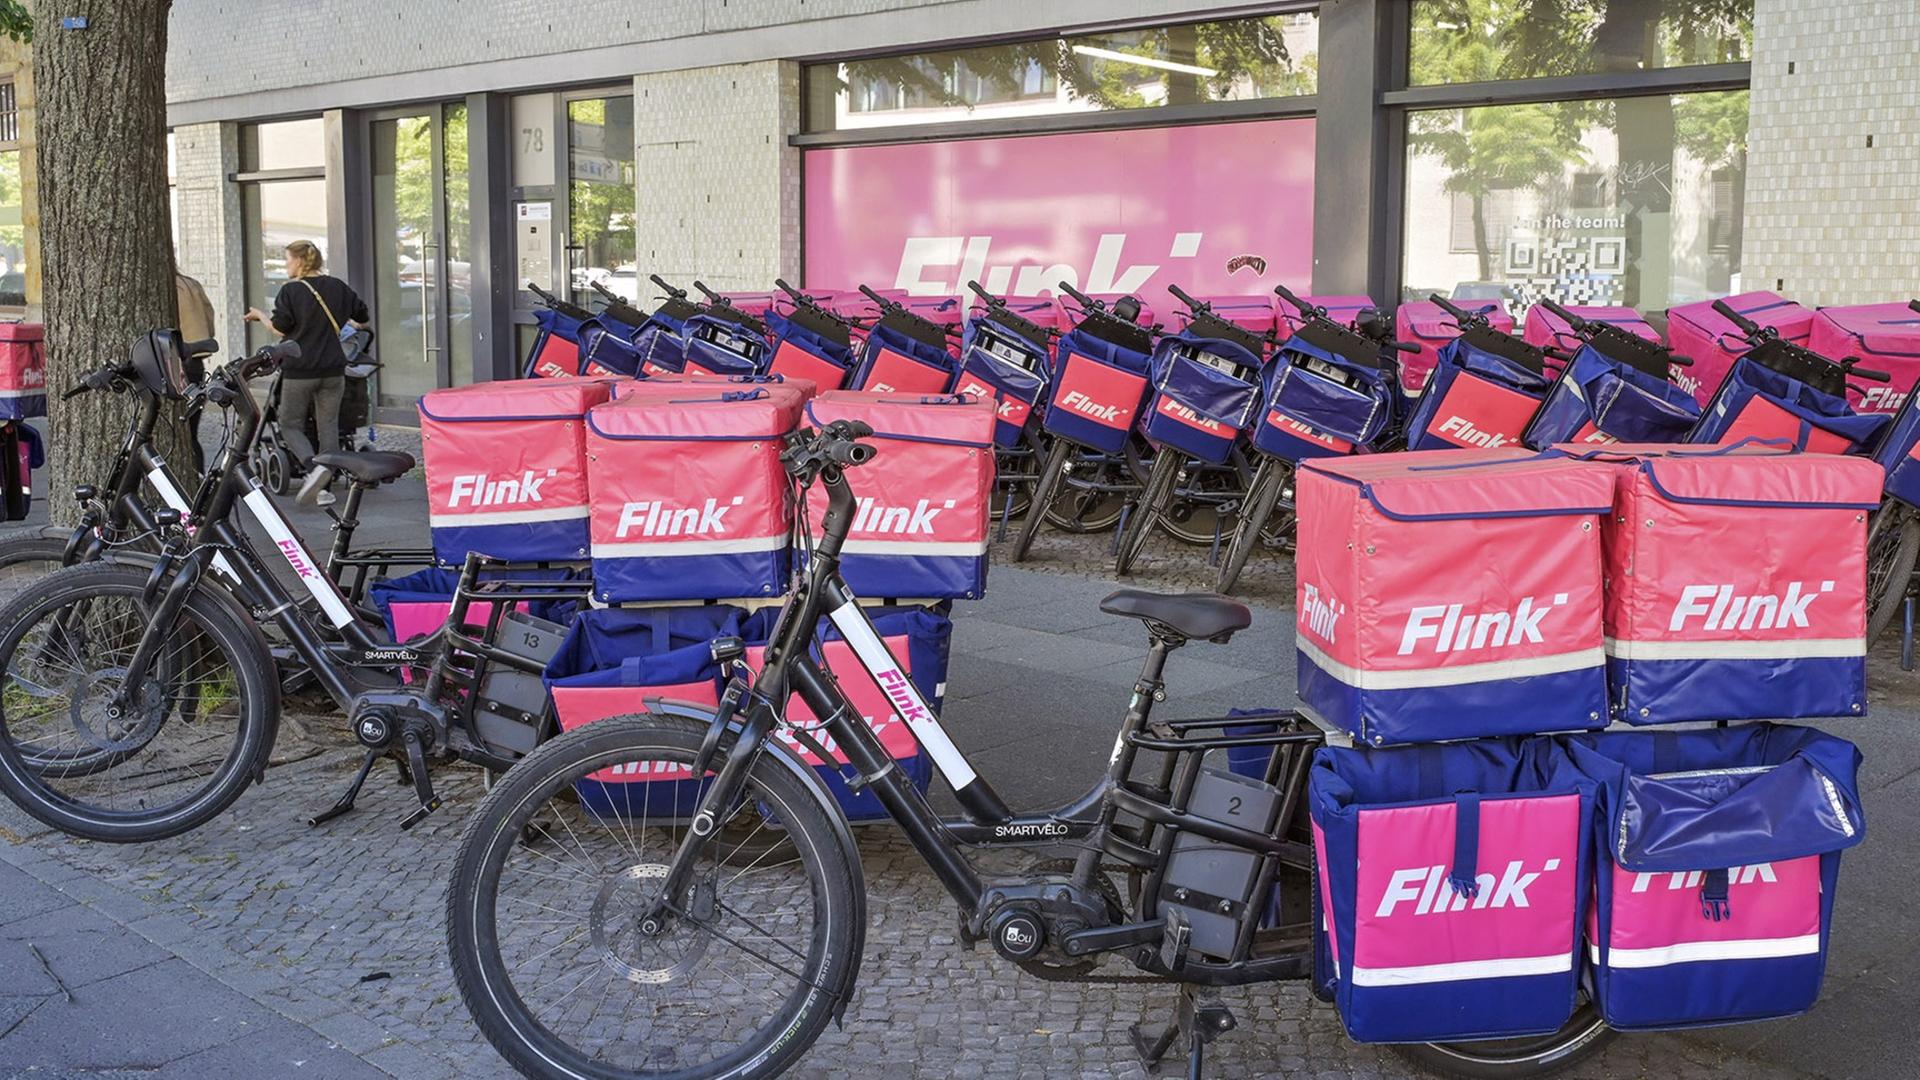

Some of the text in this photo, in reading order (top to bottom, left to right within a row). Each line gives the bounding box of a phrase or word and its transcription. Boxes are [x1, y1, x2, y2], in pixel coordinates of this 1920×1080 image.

[522, 128, 543, 153] 78
[1546, 214, 1571, 229] the
[1576, 214, 1625, 229] team!
[1062, 391, 1128, 422] Flink
[1438, 416, 1518, 448] Flink
[448, 469, 557, 507] Flink
[615, 496, 744, 537] Flink
[853, 497, 956, 534] link
[278, 540, 319, 579] Flink
[1300, 582, 1345, 645] Flink
[1397, 593, 1568, 655] Flink
[1669, 581, 1835, 631] Flink
[523, 632, 540, 649] 13
[877, 669, 933, 723] Flink
[1227, 797, 1242, 815] 2
